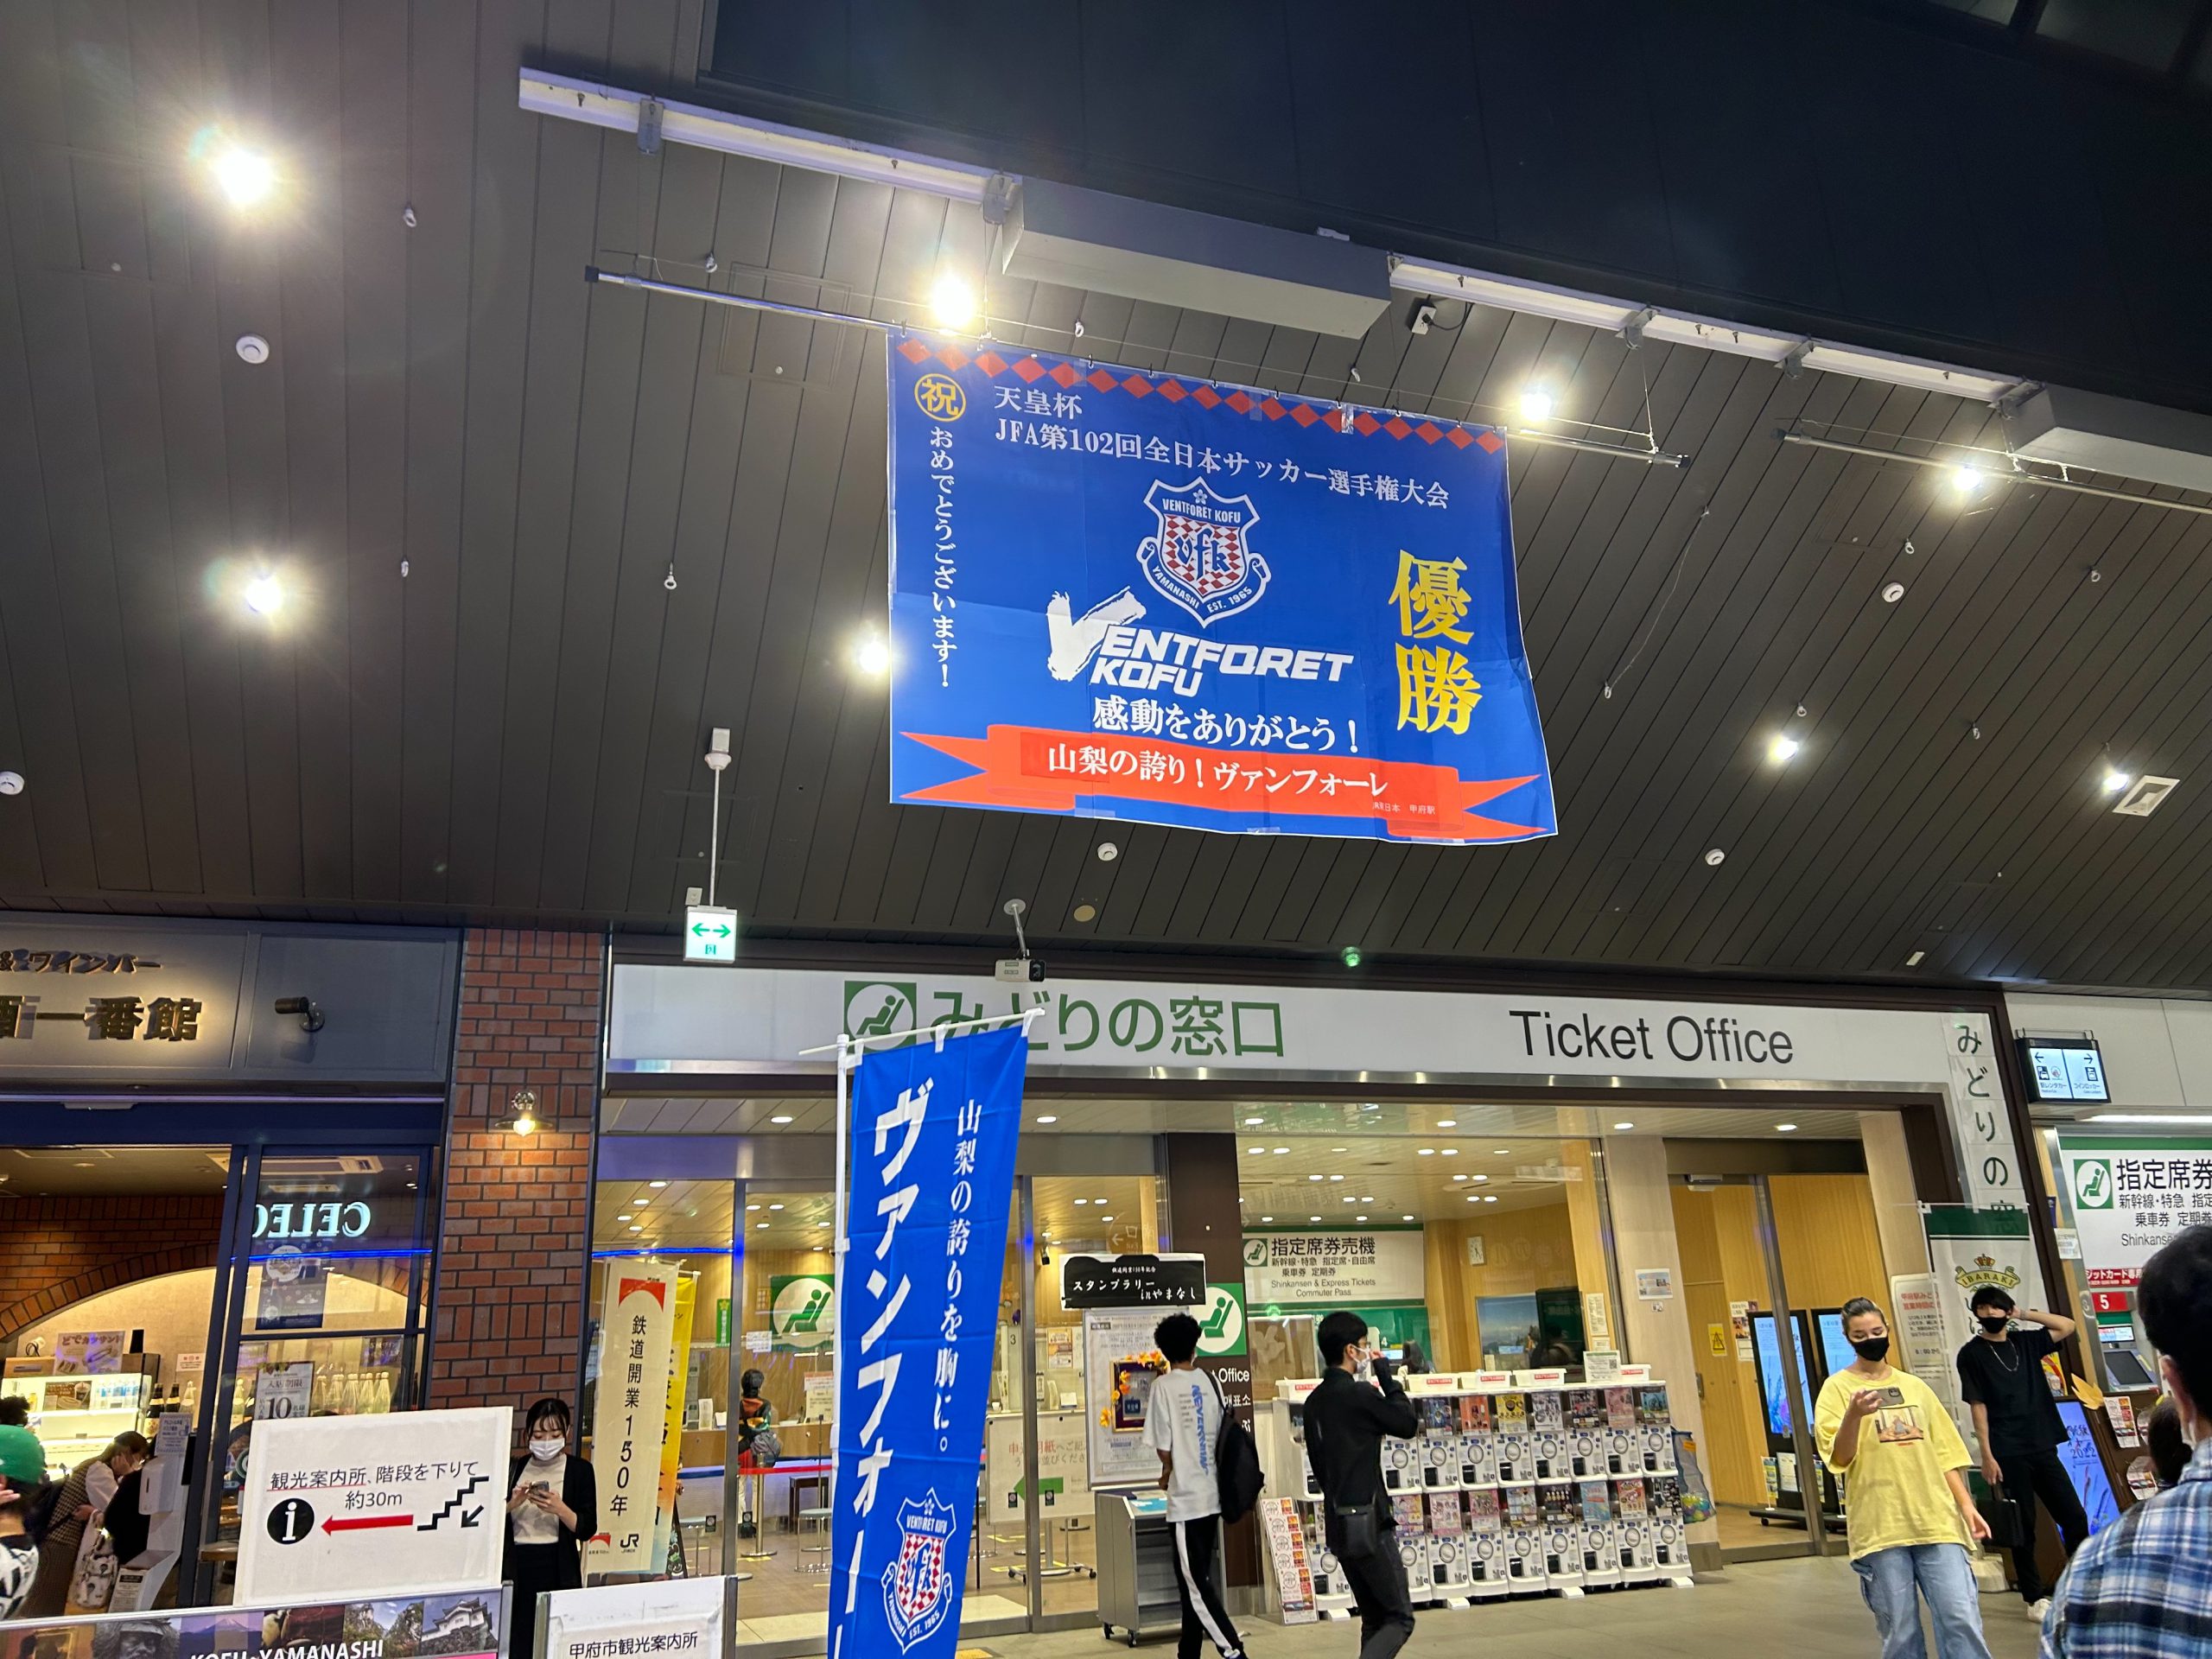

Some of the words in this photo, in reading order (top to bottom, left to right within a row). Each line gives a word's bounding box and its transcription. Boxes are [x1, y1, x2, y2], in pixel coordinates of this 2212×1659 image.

[920, 378, 959, 417] 祝
[995, 385, 1084, 420] 天皇杯
[995, 418, 1450, 509] JFA第102回全日本サッカー選手権大会
[1162, 499, 1211, 520] VENTFORET
[1214, 509, 1241, 524] KOFU
[1152, 565, 1200, 610] YAMANASHI
[1206, 601, 1227, 613] EST.
[1228, 586, 1253, 605] 1965
[1046, 587, 1355, 683] VENTFORET
[1388, 549, 1483, 735] 優勝
[1089, 657, 1203, 698] KOFU
[1092, 694, 1359, 753] 感動をありがとう！
[1409, 804, 1436, 816] 甲府駅
[930, 991, 1285, 1058] みどりの窓口
[1509, 1009, 1654, 1060] Ticket
[1667, 1014, 1794, 1065] Office
[2119, 1192, 2185, 1210] 新幹線・特急
[2135, 1211, 2171, 1228] 乗車券
[1271, 1236, 1376, 1256] 指定席券売機
[1271, 1256, 1318, 1267] 新幹線・特急
[1322, 1255, 1376, 1266] 指定席・自由席
[933, 1098, 982, 1452] 山梨の誇りを胸に。
[1282, 1267, 1306, 1277] 乗車券
[1311, 1266, 1336, 1277] 定期券
[1961, 1273, 2014, 1287] IBARAKI
[1072, 1279, 1156, 1292] スタンプラリー
[1271, 1279, 1313, 1288] Shinkansen
[1321, 1279, 1350, 1287] Express
[1351, 1278, 1376, 1287] Tickets
[1295, 1287, 1332, 1298] Commuter
[1334, 1287, 1352, 1296] Pass
[1140, 1287, 1196, 1300] inやまなし
[2100, 1294, 2110, 1310] 5
[1009, 1333, 1017, 1345] 3
[1381, 1337, 1388, 1347] 4
[1217, 1367, 1250, 1383] Office
[266, 1396, 293, 1419] 10
[609, 1314, 647, 1517] 鉄道開業150年
[270, 1460, 479, 1491] 観光案内所、階段を下りて
[345, 1490, 403, 1510] 約30m
[620, 1533, 639, 1549] JR
[569, 1630, 699, 1659] 甲府市観光案内所
